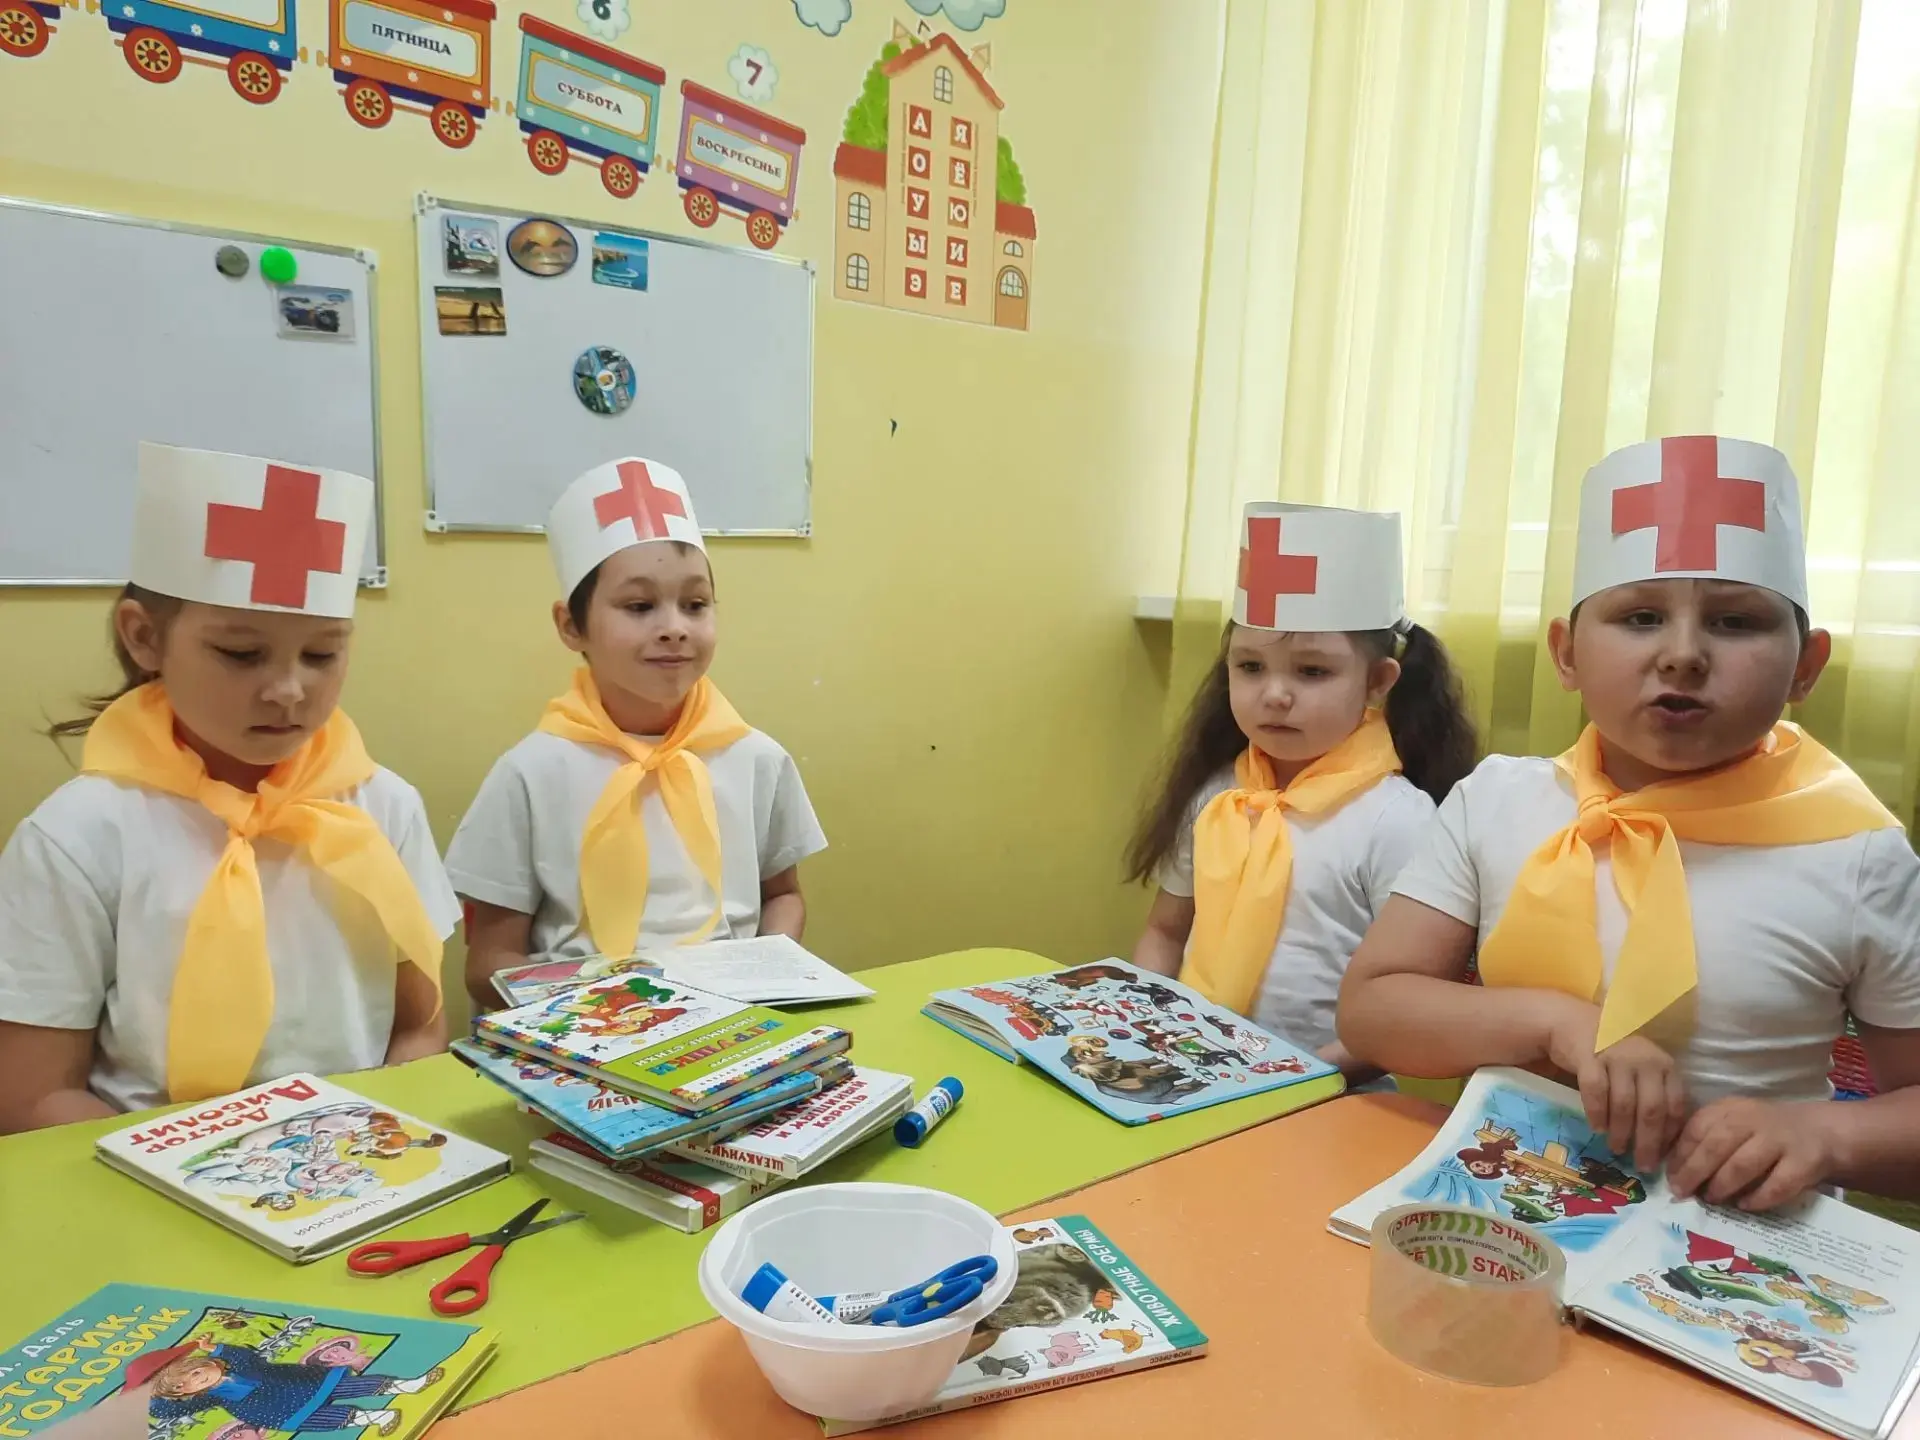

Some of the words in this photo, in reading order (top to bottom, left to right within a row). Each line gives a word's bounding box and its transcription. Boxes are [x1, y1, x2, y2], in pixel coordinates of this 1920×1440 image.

[592, 0, 611, 21] 6
[371, 23, 452, 56] ПЯТНИЦА
[746, 57, 763, 86] 7
[557, 81, 623, 115] СУББОТА
[912, 111, 928, 133] А
[954, 123, 968, 144] Я
[696, 135, 782, 179] ВОСКРЕСЕНЬЕ
[912, 152, 926, 174] О
[911, 192, 925, 212] У
[949, 202, 967, 222] Ю
[908, 232, 926, 254] Ы
[949, 242, 965, 262] И
[909, 273, 922, 293] Э
[647, 1018, 784, 1077] ИГРУШКИ
[130, 1078, 319, 1146] АЙБОЛИТ
[789, 1080, 868, 1130] МЫШИНЫЙ
[812, 1094, 869, 1129] КОРОЛЬ
[1395, 1211, 1441, 1231] STAFF
[1490, 1219, 1538, 1255] STAFF
[1073, 1228, 1118, 1265] ФЕРМЫ
[1110, 1266, 1183, 1328] ЖИВОТНЫЕ
[21, 1317, 85, 1358] Даль
[0, 1307, 192, 1438] ГОДОВИК
